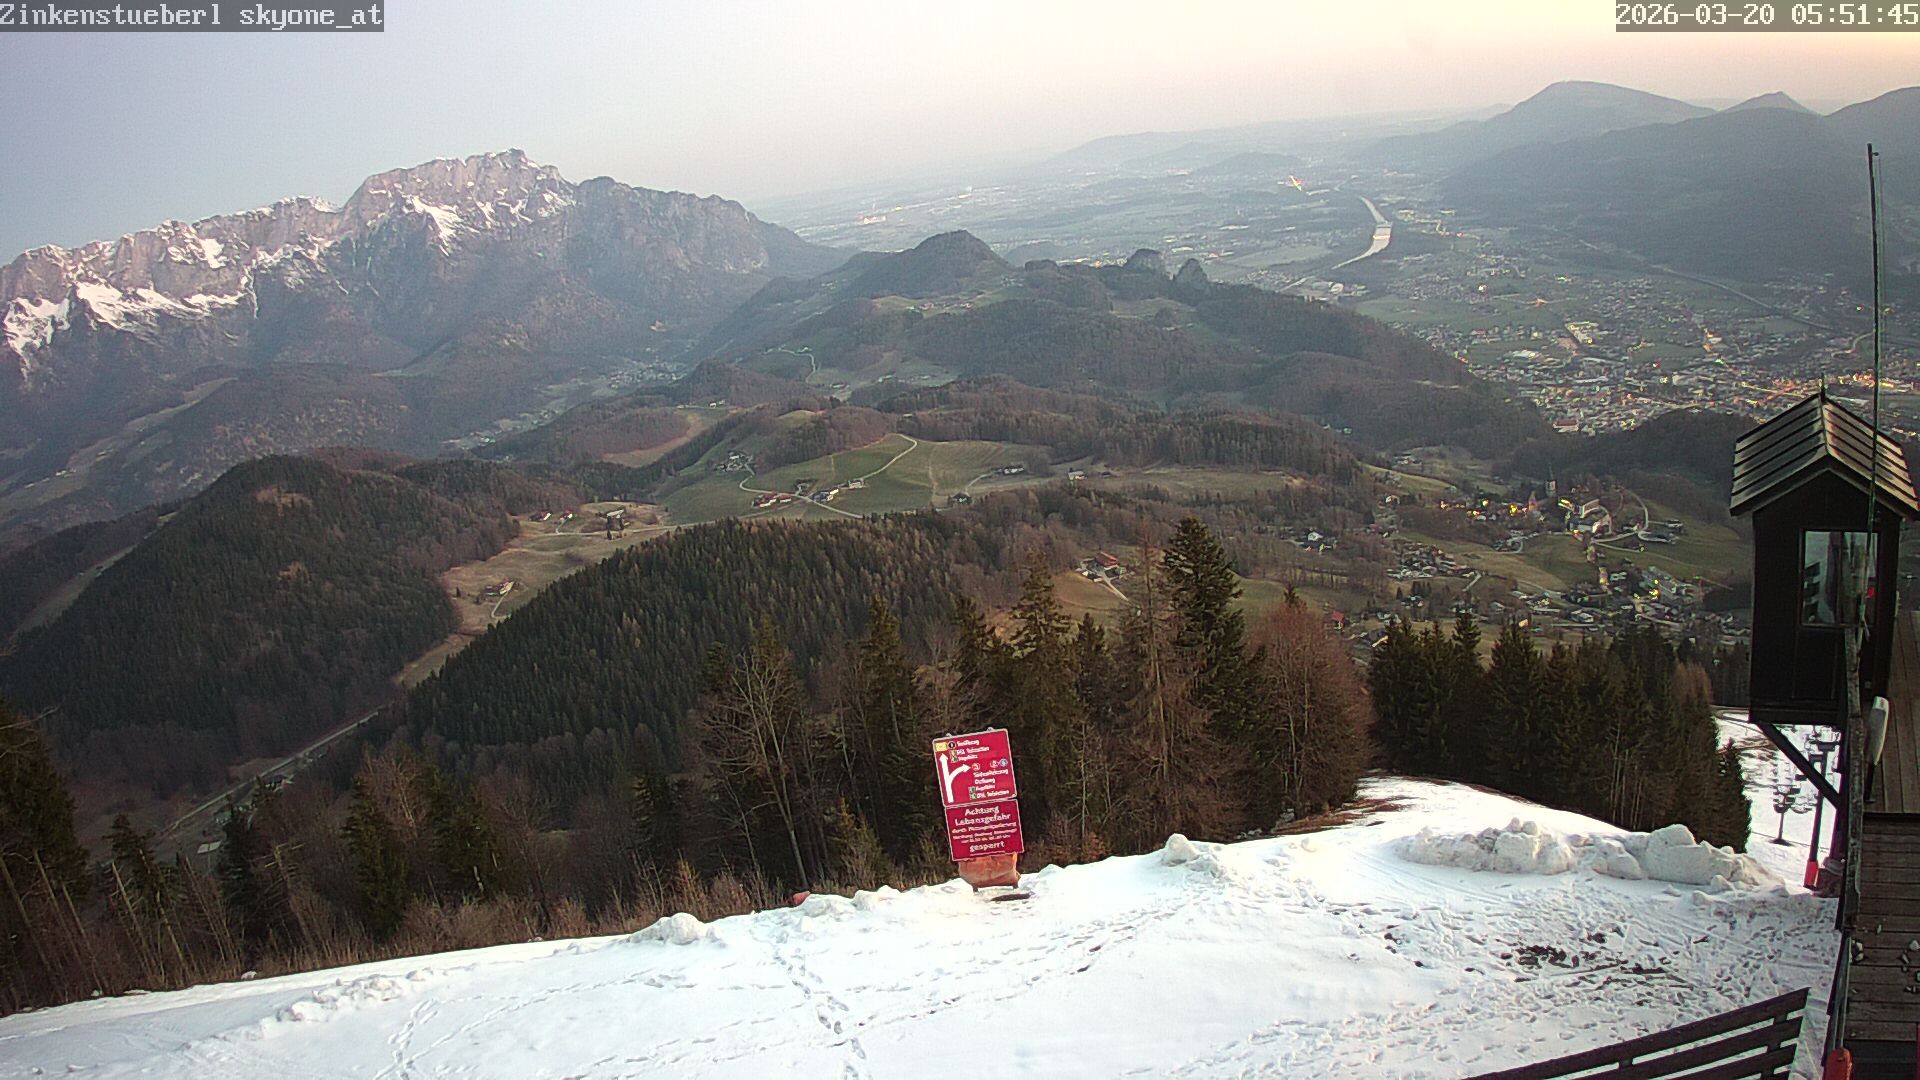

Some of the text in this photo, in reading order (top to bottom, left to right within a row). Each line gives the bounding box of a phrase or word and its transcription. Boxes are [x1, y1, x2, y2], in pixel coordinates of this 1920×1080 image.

[965, 806, 1000, 816] Achtung
[954, 813, 1011, 826] Lebensgefahr
[969, 840, 1005, 852] gesperrt
